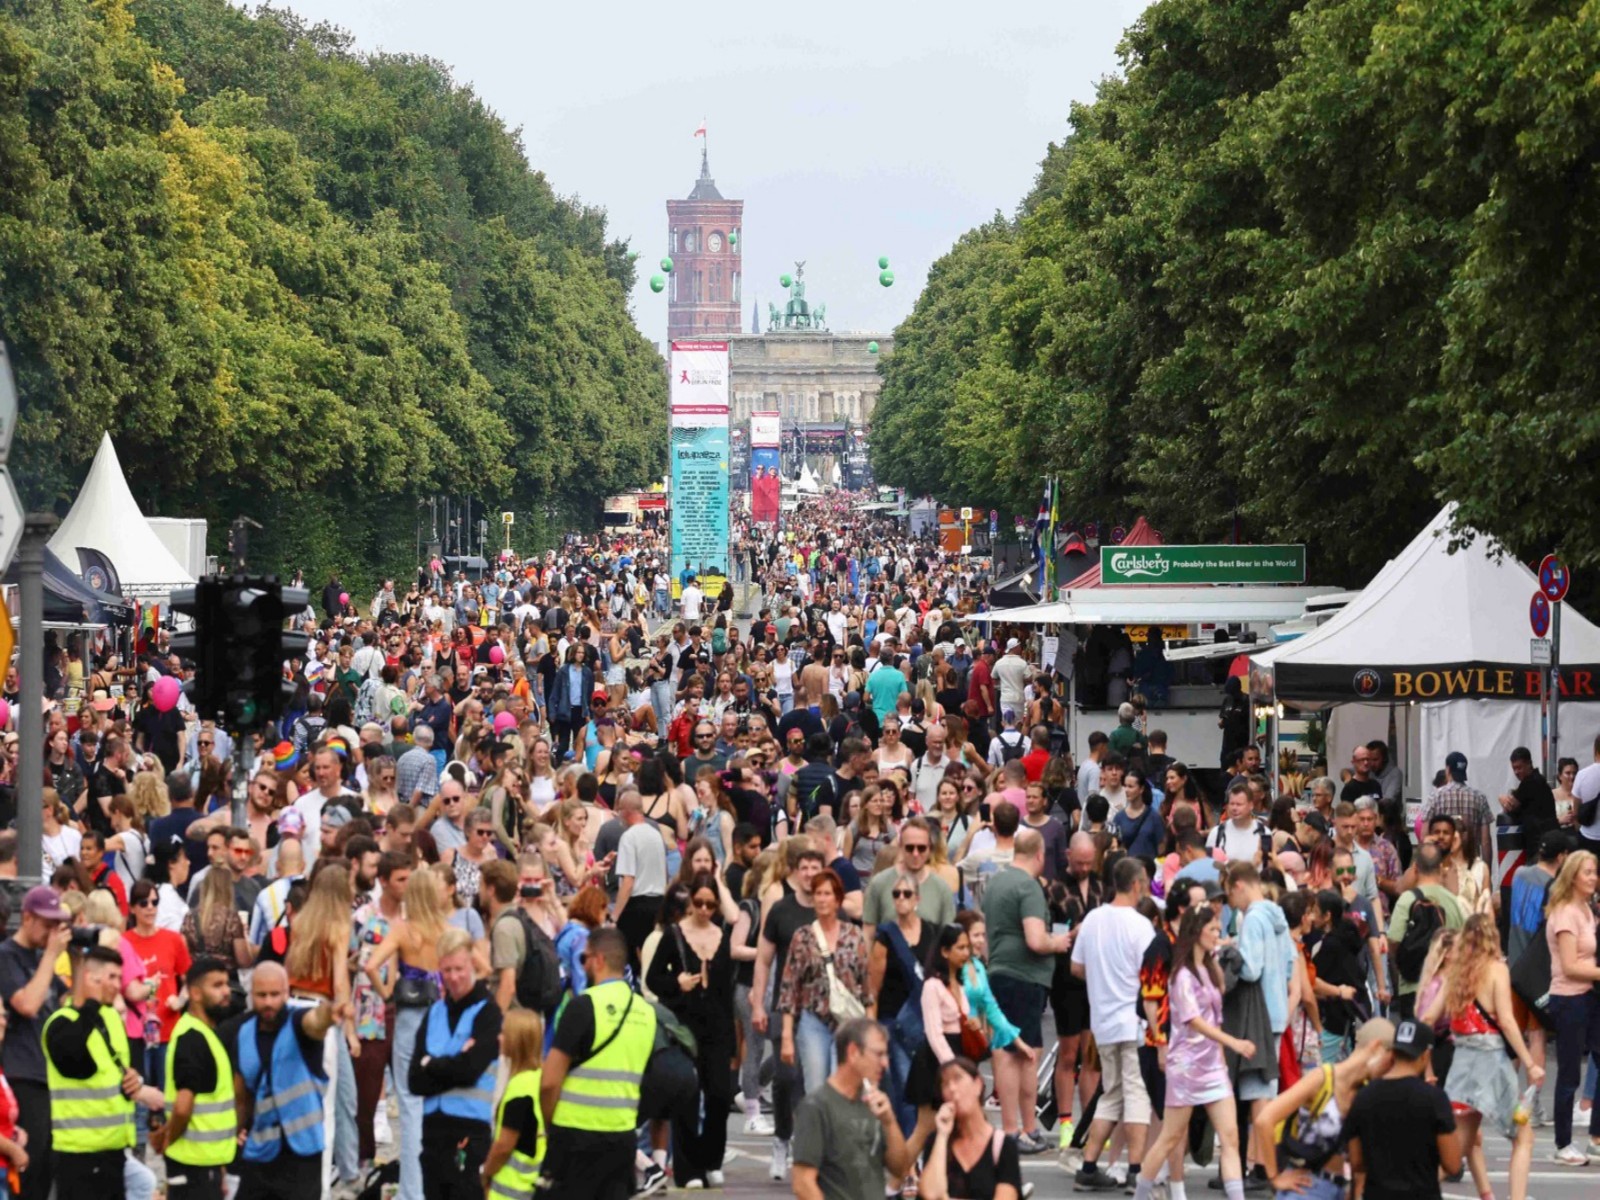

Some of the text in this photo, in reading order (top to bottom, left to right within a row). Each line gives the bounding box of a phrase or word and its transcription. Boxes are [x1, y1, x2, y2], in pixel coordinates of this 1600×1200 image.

[1111, 553, 1169, 578] Carlsberg
[1172, 560, 1204, 569] Probably
[1218, 560, 1234, 568] Best
[1393, 669, 1514, 697] BOWLE
